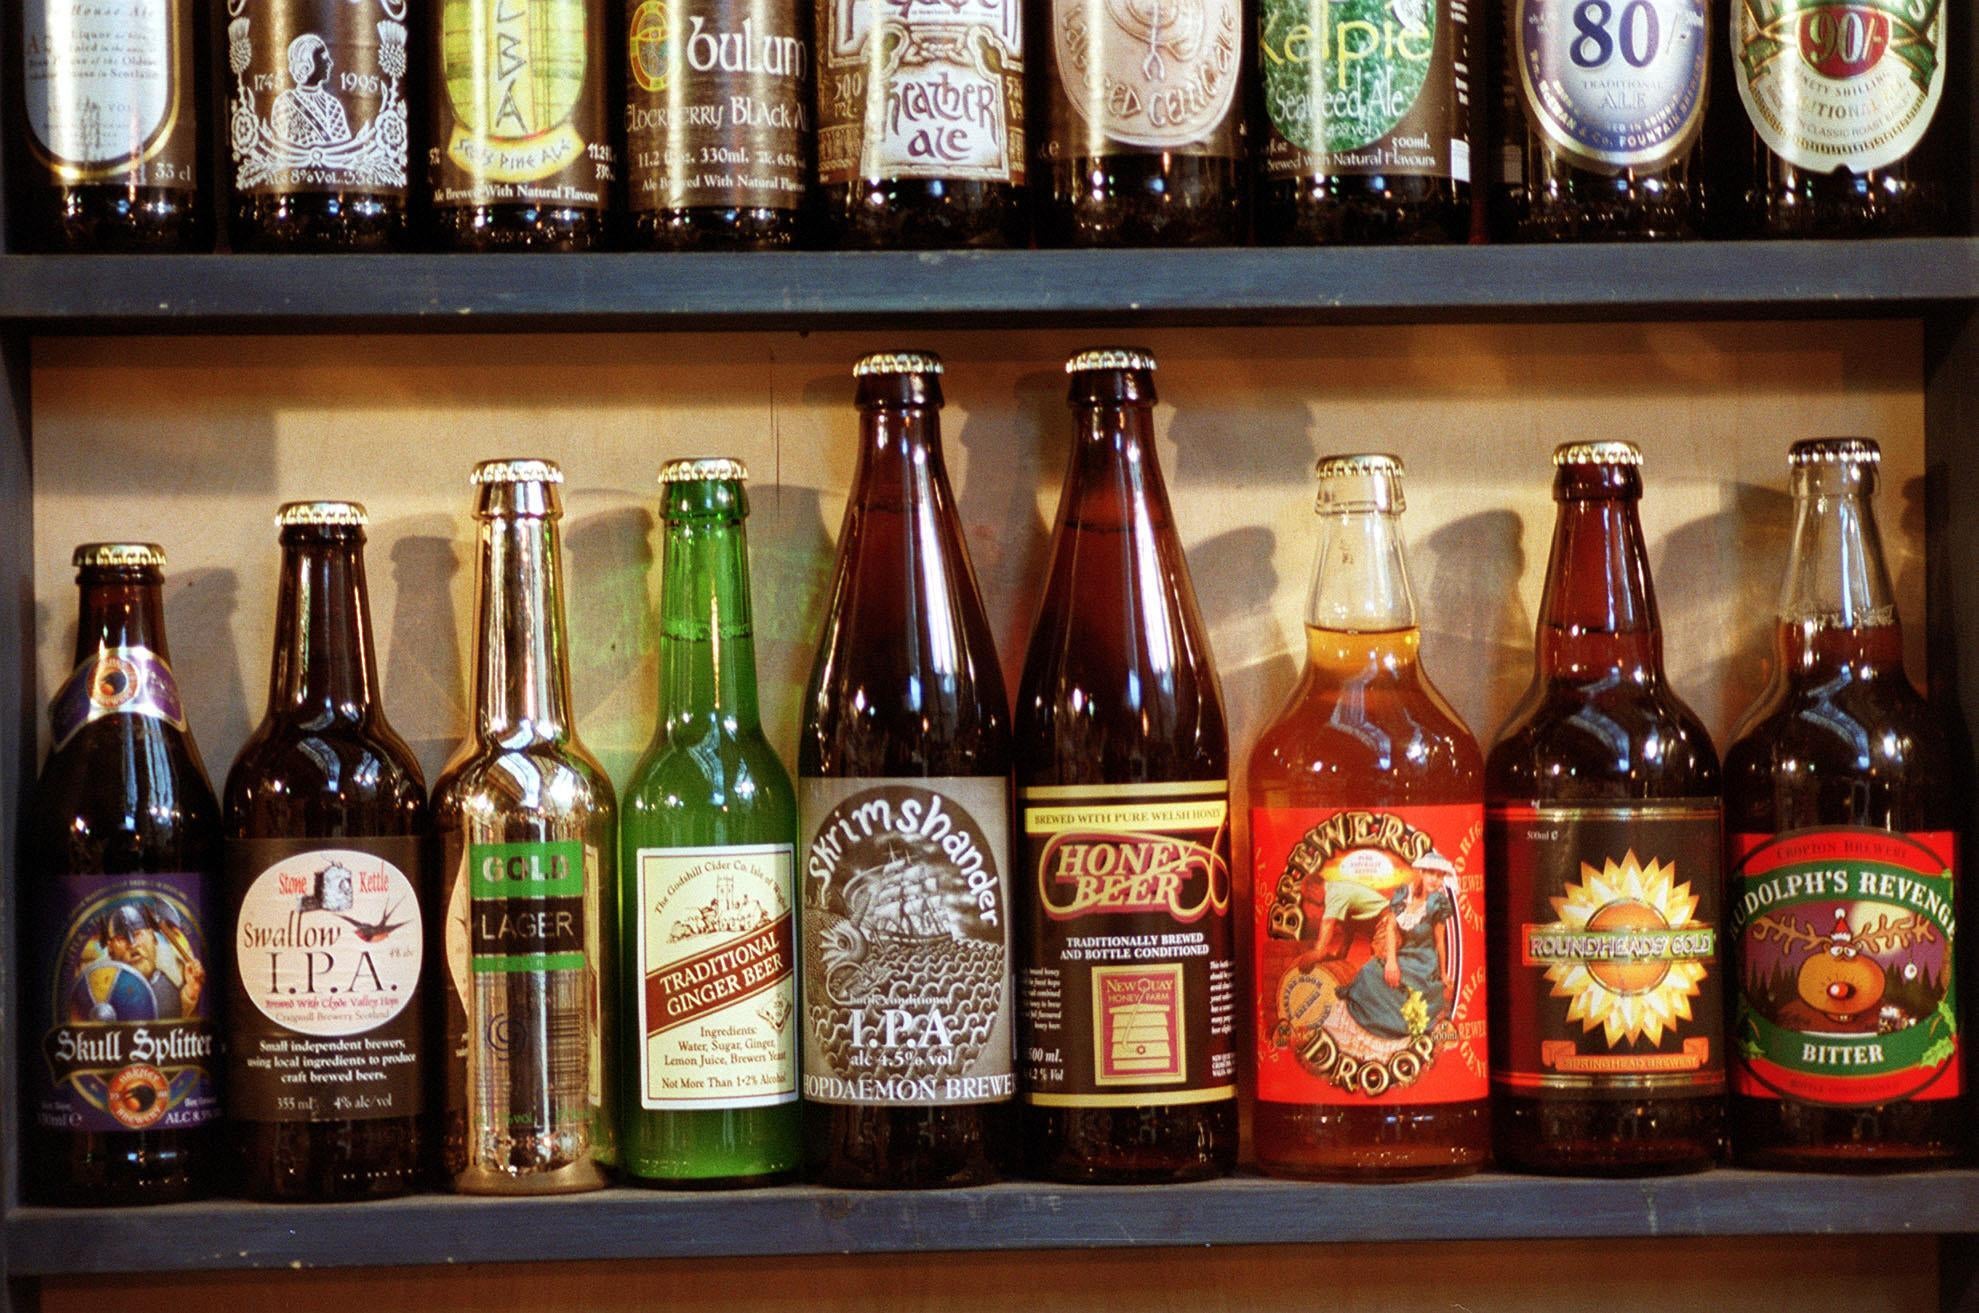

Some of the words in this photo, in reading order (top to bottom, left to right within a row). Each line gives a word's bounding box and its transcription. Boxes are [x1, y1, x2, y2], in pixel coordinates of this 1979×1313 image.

[1260, 0, 1432, 90] Kelpie
[1274, 66, 1363, 122] Seaeed
[1367, 64, 1404, 118] Ale
[1333, 148, 1382, 167] Natural
[1385, 148, 1436, 167] Flavours
[485, 184, 514, 198] With
[516, 185, 561, 199] Natural
[564, 185, 599, 201] Flavors
[704, 174, 734, 188] With
[737, 174, 779, 189] Natural
[1034, 813, 1075, 825] BREWED
[1077, 813, 1112, 824] WITH
[1114, 811, 1150, 823] PURE
[1151, 810, 1191, 821] WELSH
[1192, 807, 1221, 820] HONEY
[482, 855, 571, 883] GOLD
[809, 795, 999, 928] Skrimshander
[1055, 841, 1197, 878] HONEY
[278, 873, 308, 896] Stone
[359, 860, 390, 893] Kettle
[1268, 809, 1434, 941] BREWERS
[655, 898, 670, 915] The
[667, 865, 703, 897] Godshill
[704, 860, 732, 872] Cider
[1072, 873, 1182, 907] BEER
[244, 910, 341, 949] Swallow
[482, 911, 575, 940] LAGER
[1066, 935, 1158, 949] TRADITIONALLY
[1161, 932, 1204, 945] BREWED
[1671, 934, 1712, 955] GOLD
[660, 931, 781, 995] TRADITIONAL
[1060, 949, 1083, 961] AND
[1084, 947, 1132, 960] BOTTLE
[1134, 944, 1210, 959] CONDITIONED
[265, 951, 398, 994] I.P.A.
[667, 976, 743, 1017] GINGER
[742, 952, 785, 988] BEER
[1108, 993, 1139, 1002] HONEY
[1145, 992, 1169, 1002] FARM
[850, 1008, 954, 1049] I.P.A
[55, 1030, 122, 1062] Skull
[129, 1027, 213, 1066] Splitter
[259, 1040, 289, 1051] Small
[291, 1039, 362, 1054] independent
[678, 1041, 709, 1053] Water,
[1802, 1043, 1886, 1065] BITTER
[247, 1058, 273, 1069] using
[274, 1055, 300, 1068] local
[302, 1054, 366, 1068] ingredients
[368, 1054, 381, 1065] to
[382, 1052, 417, 1067] produce
[664, 1054, 698, 1066] Lemon
[700, 1054, 728, 1068] Juice,
[850, 1050, 873, 1066] alc
[879, 1050, 926, 1067] 4.5%
[928, 1049, 953, 1066] vol
[1302, 1027, 1435, 1099] DROOP
[281, 1071, 308, 1083] craft
[310, 1069, 353, 1083] brewed
[356, 1068, 388, 1081] beers.
[662, 1077, 679, 1089] Not
[680, 1076, 705, 1089] More
[707, 1076, 733, 1088] Than
[760, 1072, 787, 1085] Alcohol
[946, 1072, 1016, 1099] BREWE
[1050, 1068, 1064, 1081] Vol
[333, 1097, 353, 1110] 4%
[165, 1111, 191, 1125] ALC
